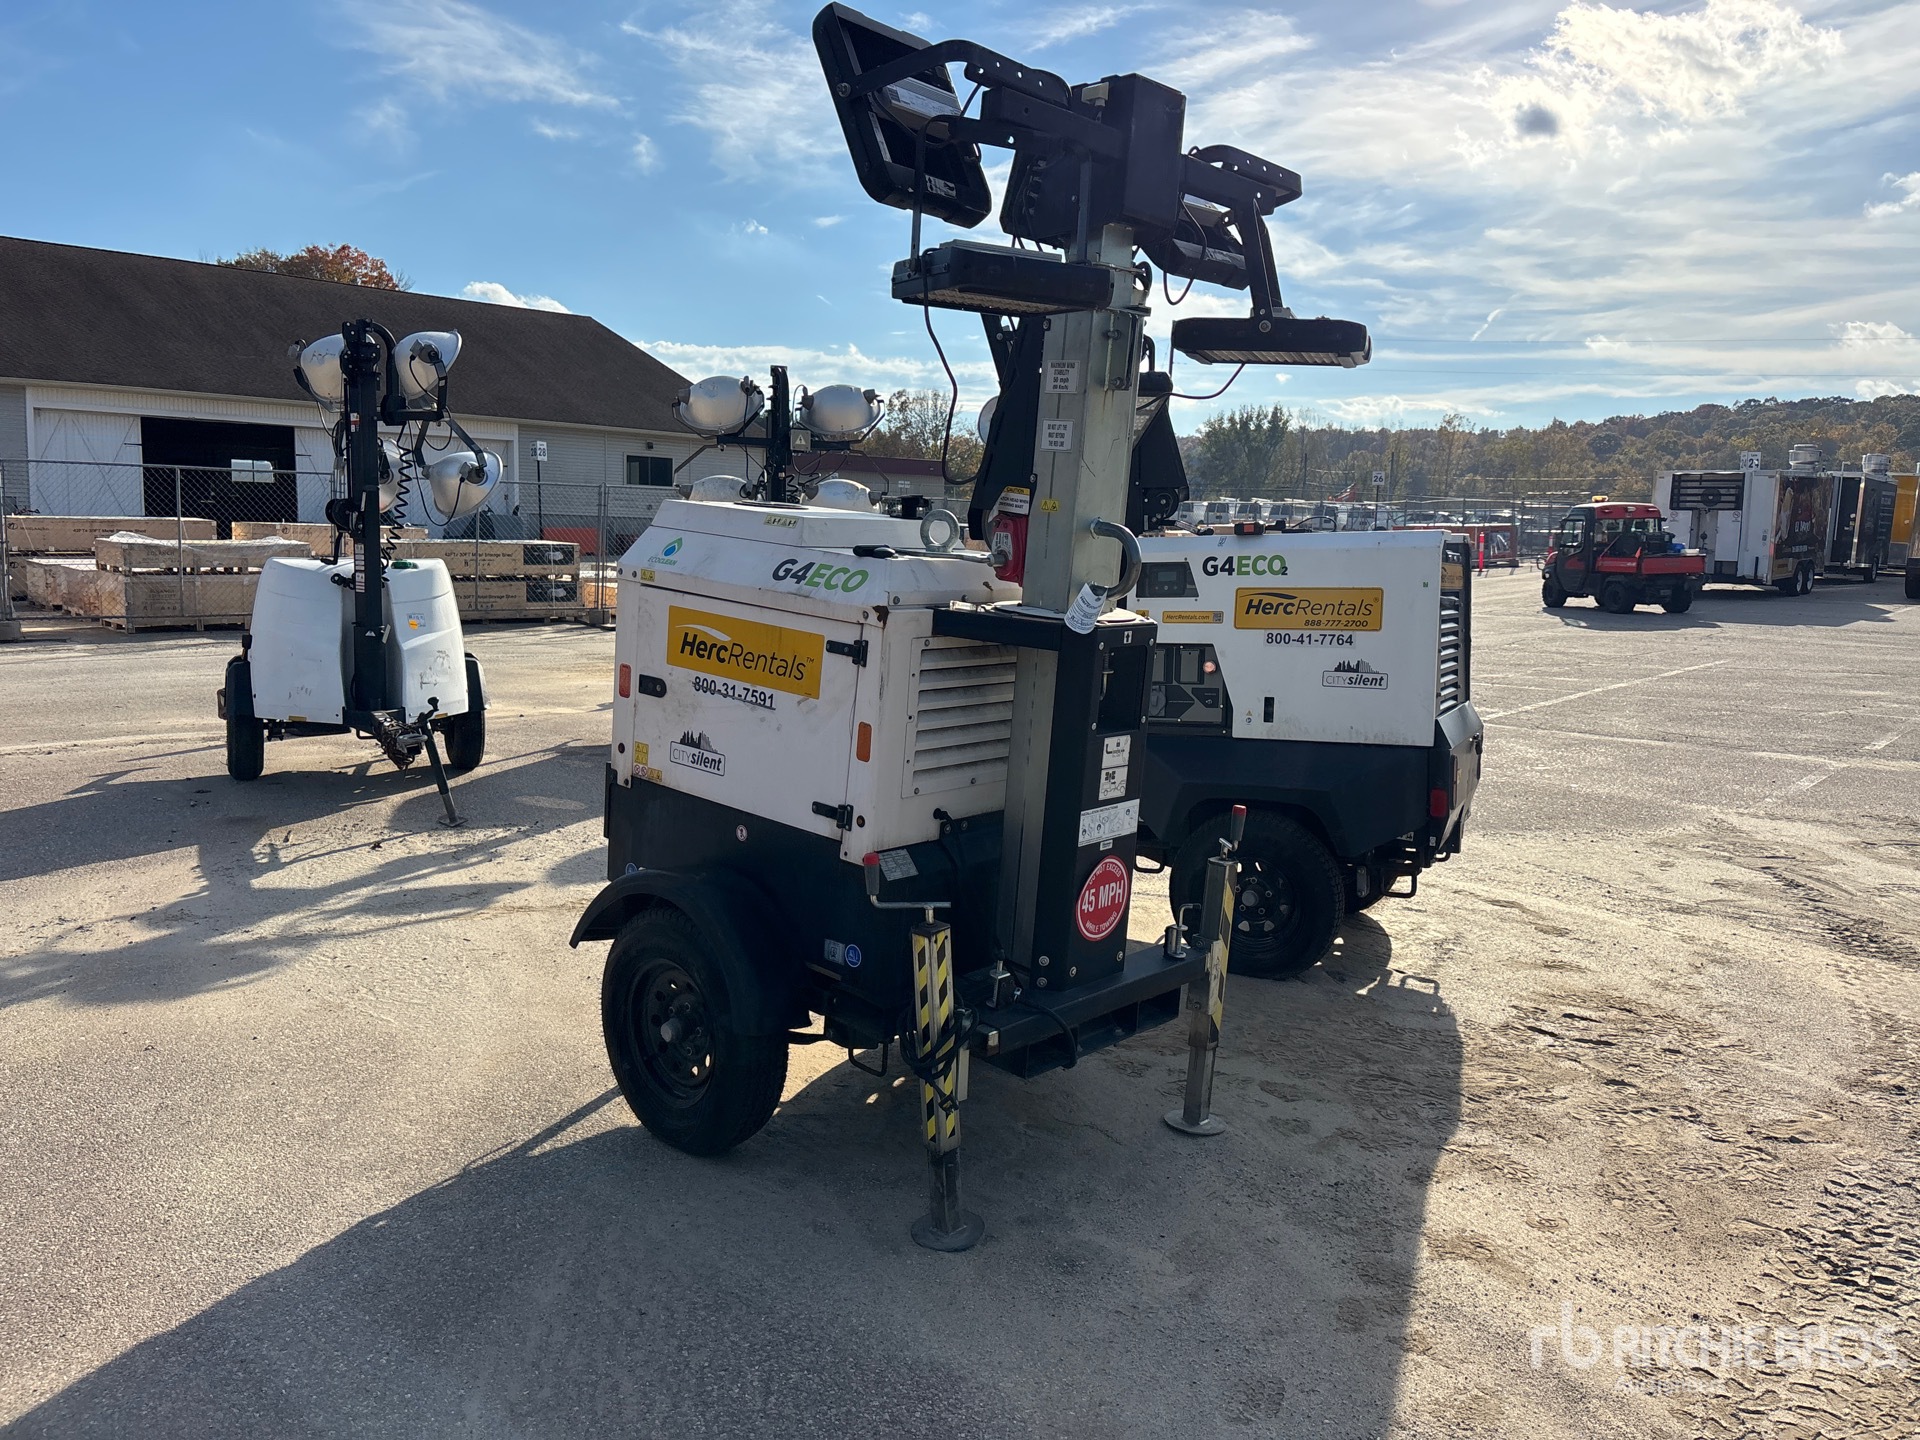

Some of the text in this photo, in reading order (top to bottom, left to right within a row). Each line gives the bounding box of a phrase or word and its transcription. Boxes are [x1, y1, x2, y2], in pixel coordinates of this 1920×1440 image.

[538, 447, 546, 457] 28
[1373, 475, 1384, 483] 26
[1006, 486, 1025, 494] CAUTION
[647, 556, 679, 566] ECOCLEAN
[772, 558, 869, 593] G4ECO
[1245, 598, 1374, 617] HercRentals
[1166, 613, 1210, 621] HercRentals.com
[1304, 619, 1369, 628] 888-777-2700
[1266, 632, 1354, 646] 800-41-7764
[680, 632, 807, 681] HercRentals
[1325, 673, 1385, 687] CITYsilent
[693, 675, 776, 710] 800-31-7591
[672, 748, 722, 772] CITYsilent
[1106, 863, 1122, 877] EXCEED
[1082, 880, 1124, 913] 45 MPH
[1085, 910, 1118, 933] WHILE TOWING
